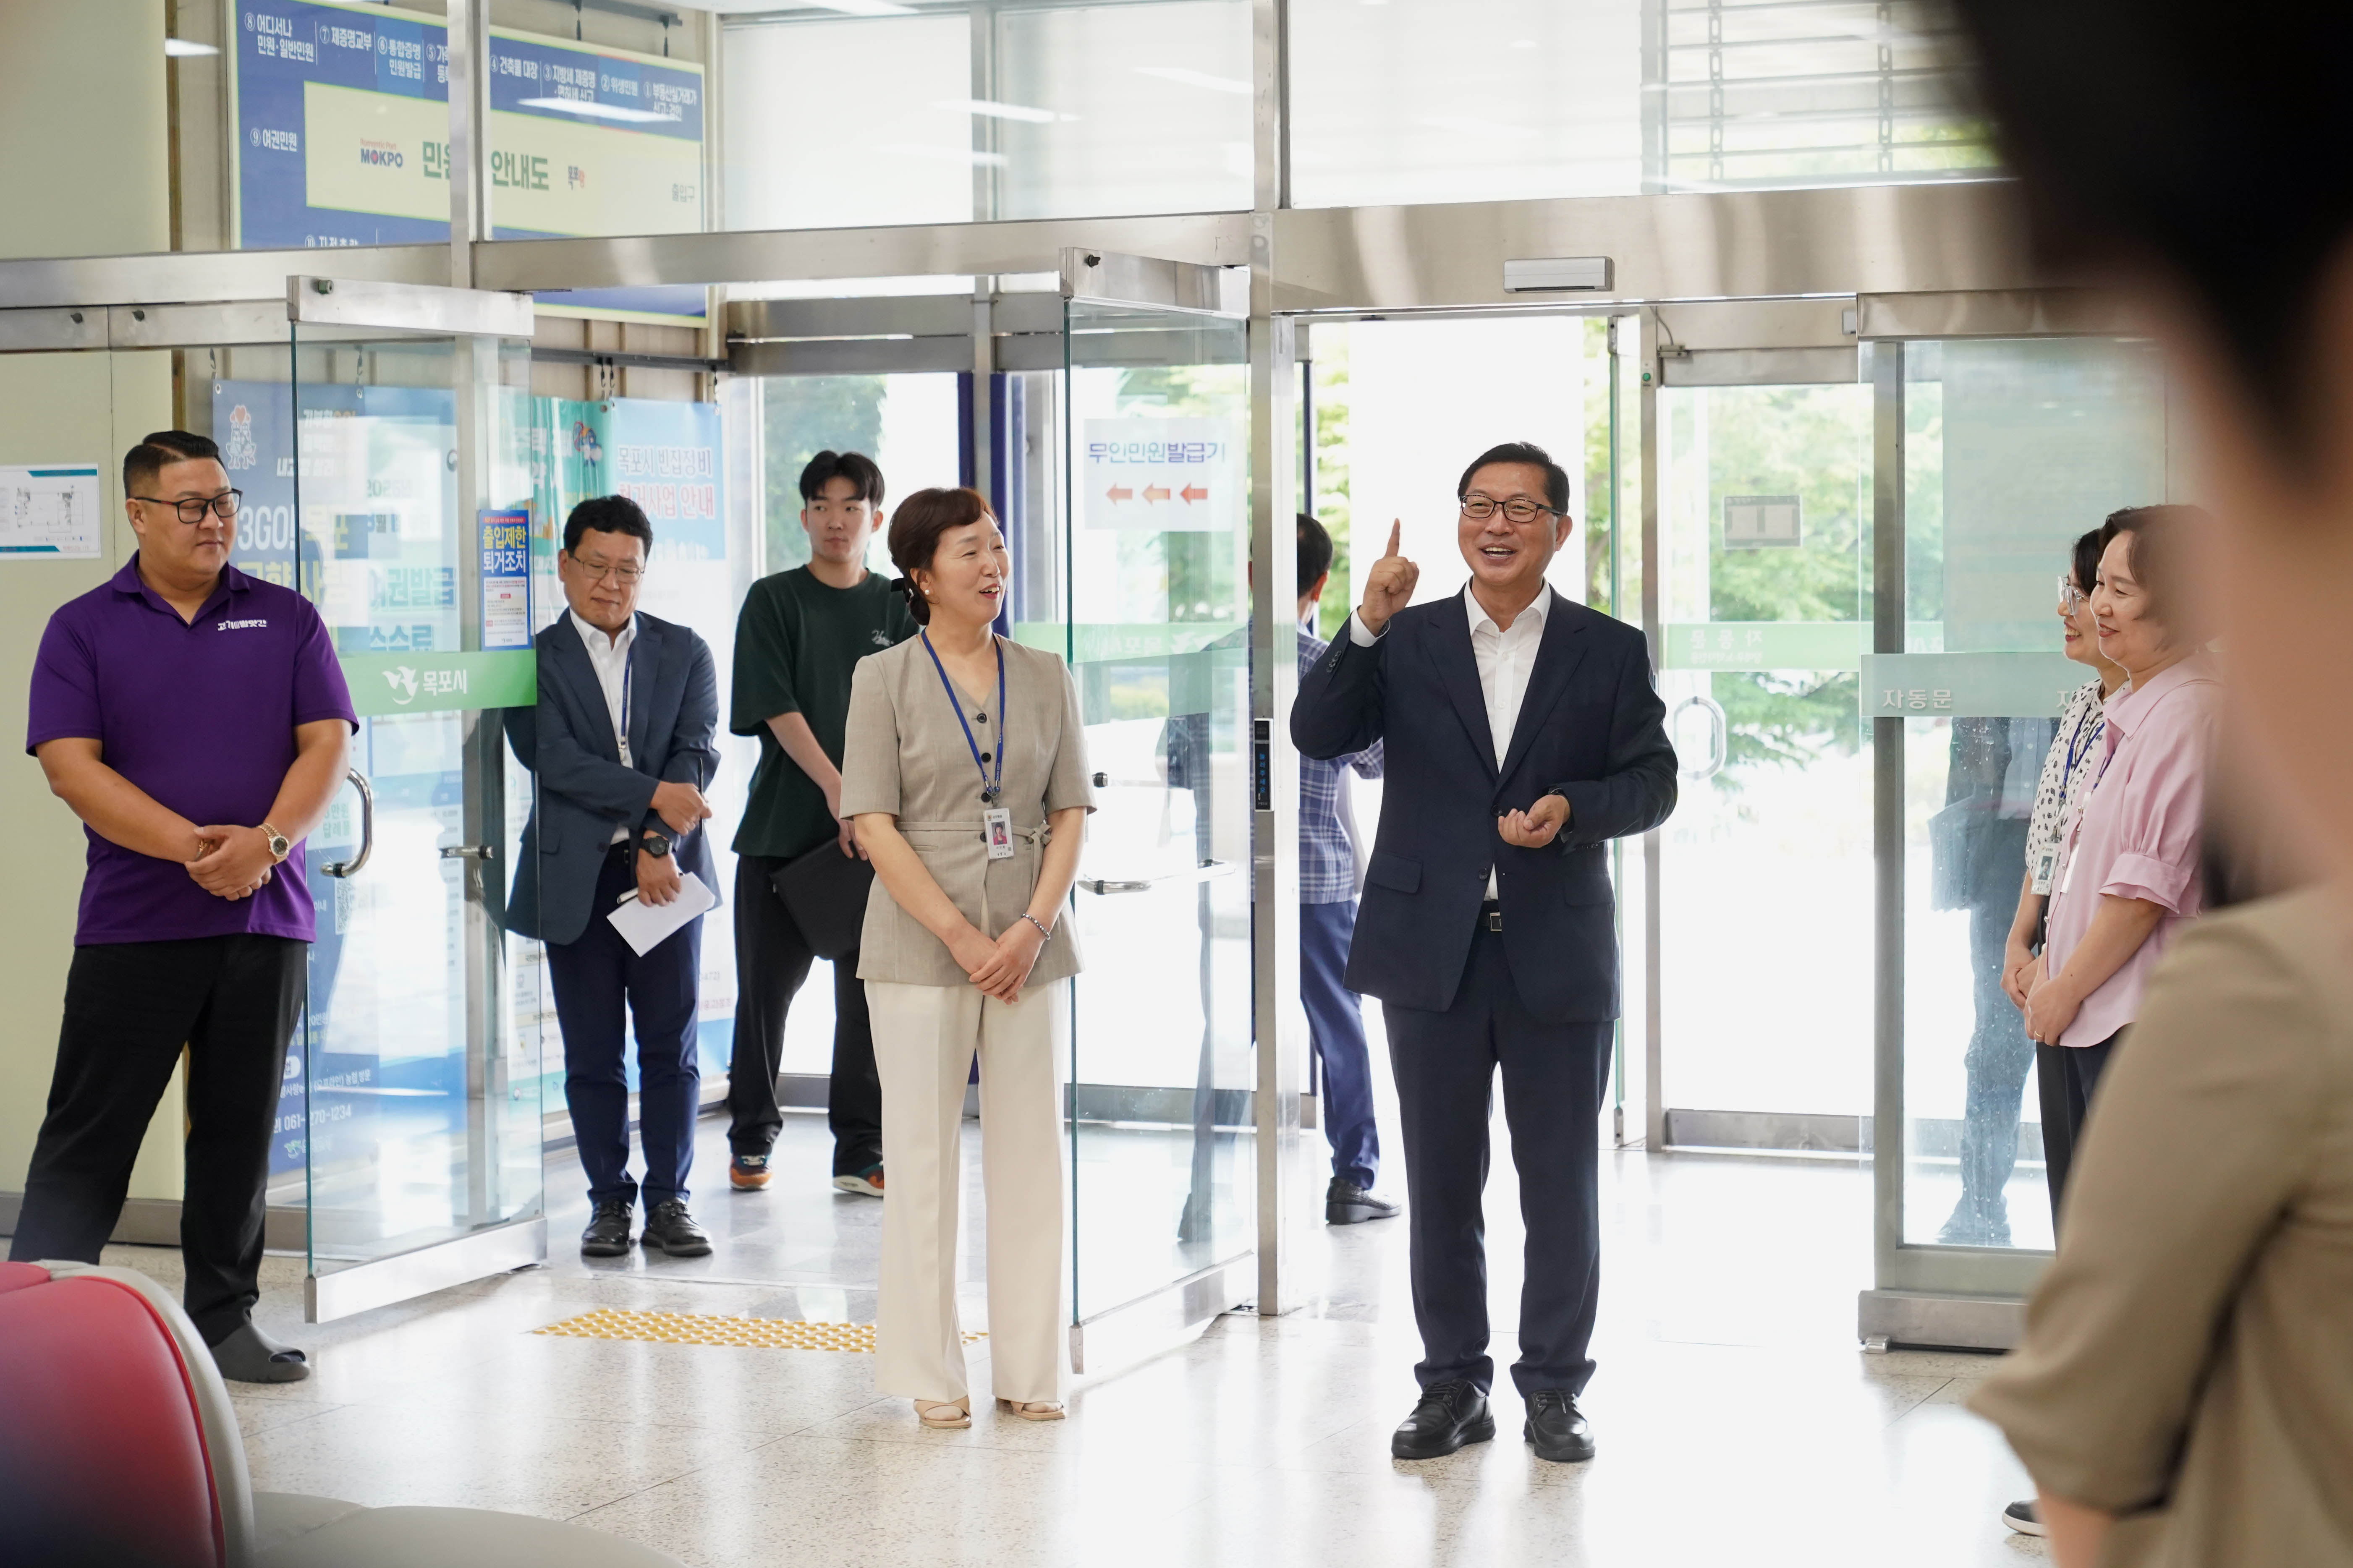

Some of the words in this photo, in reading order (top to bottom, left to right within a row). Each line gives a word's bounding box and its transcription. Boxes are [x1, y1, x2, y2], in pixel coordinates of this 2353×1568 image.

[257, 14, 292, 38] 어디서나
[331, 26, 372, 51] 제증명교부
[388, 39, 421, 60] 통합증명
[389, 59, 421, 79] 민원발급
[500, 56, 522, 78] 건축물
[523, 60, 538, 80] 대장
[552, 65, 574, 84] 지방세
[575, 68, 596, 89] 제증명
[611, 77, 638, 97] 위생민원
[262, 128, 297, 152] 여권민원
[360, 138, 385, 149] Romantic
[386, 142, 397, 150] Port
[360, 148, 403, 168] MOKPO
[491, 150, 549, 191] 안내도
[618, 447, 654, 475] 목포시
[657, 448, 711, 476] 빈집정비
[1089, 442, 1225, 464] 무인민원발급기
[681, 485, 714, 517] 안내
[483, 525, 526, 549] 출입제한
[483, 550, 526, 573] 퇴거조치
[423, 669, 467, 696] 목포시
[1882, 689, 1952, 709] 자동문
